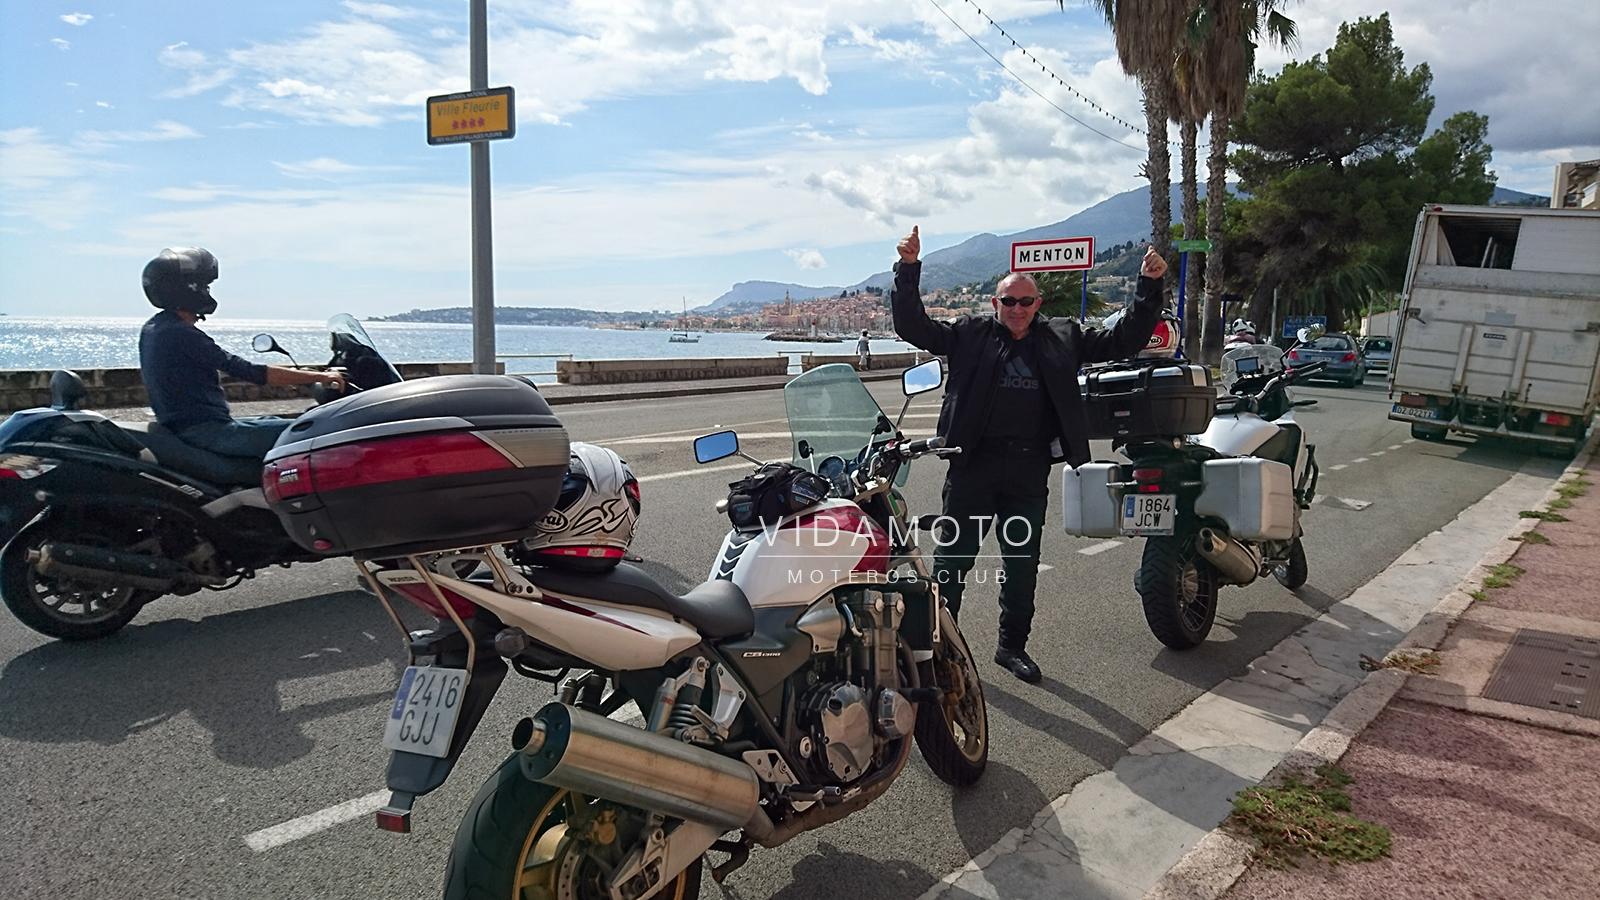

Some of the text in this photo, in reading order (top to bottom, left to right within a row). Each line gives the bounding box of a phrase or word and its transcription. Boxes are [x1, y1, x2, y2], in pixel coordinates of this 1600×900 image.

[437, 100, 500, 116] Ville Fleurie
[1019, 247, 1084, 263] MENTON
[1139, 498, 1170, 513] 1864
[1135, 513, 1161, 527] JCW
[408, 673, 461, 709] 2416
[400, 709, 440, 745] GJJ
